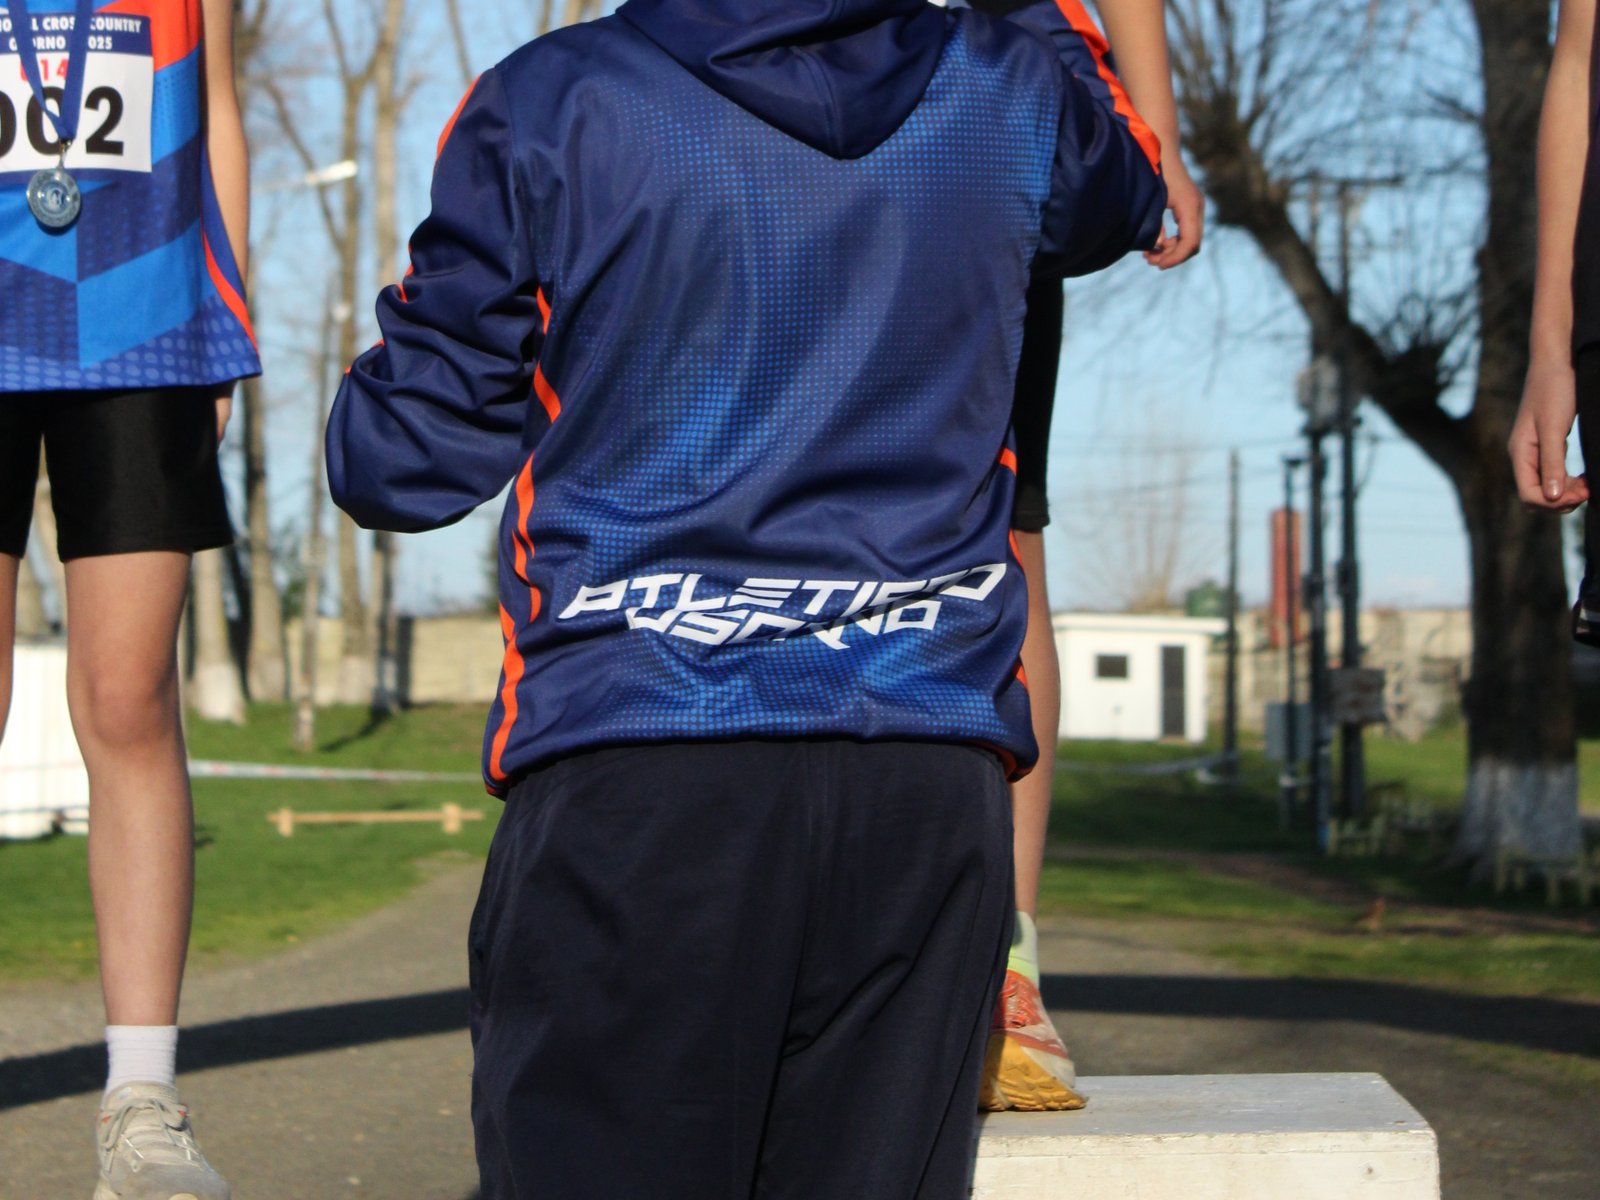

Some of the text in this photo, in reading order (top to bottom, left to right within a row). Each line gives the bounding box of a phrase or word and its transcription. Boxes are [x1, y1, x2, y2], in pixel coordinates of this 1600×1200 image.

[42, 16, 76, 31] CROS
[90, 16, 142, 33] COUNTRY
[88, 36, 113, 50] 025
[558, 562, 1007, 620] ATLETICO
